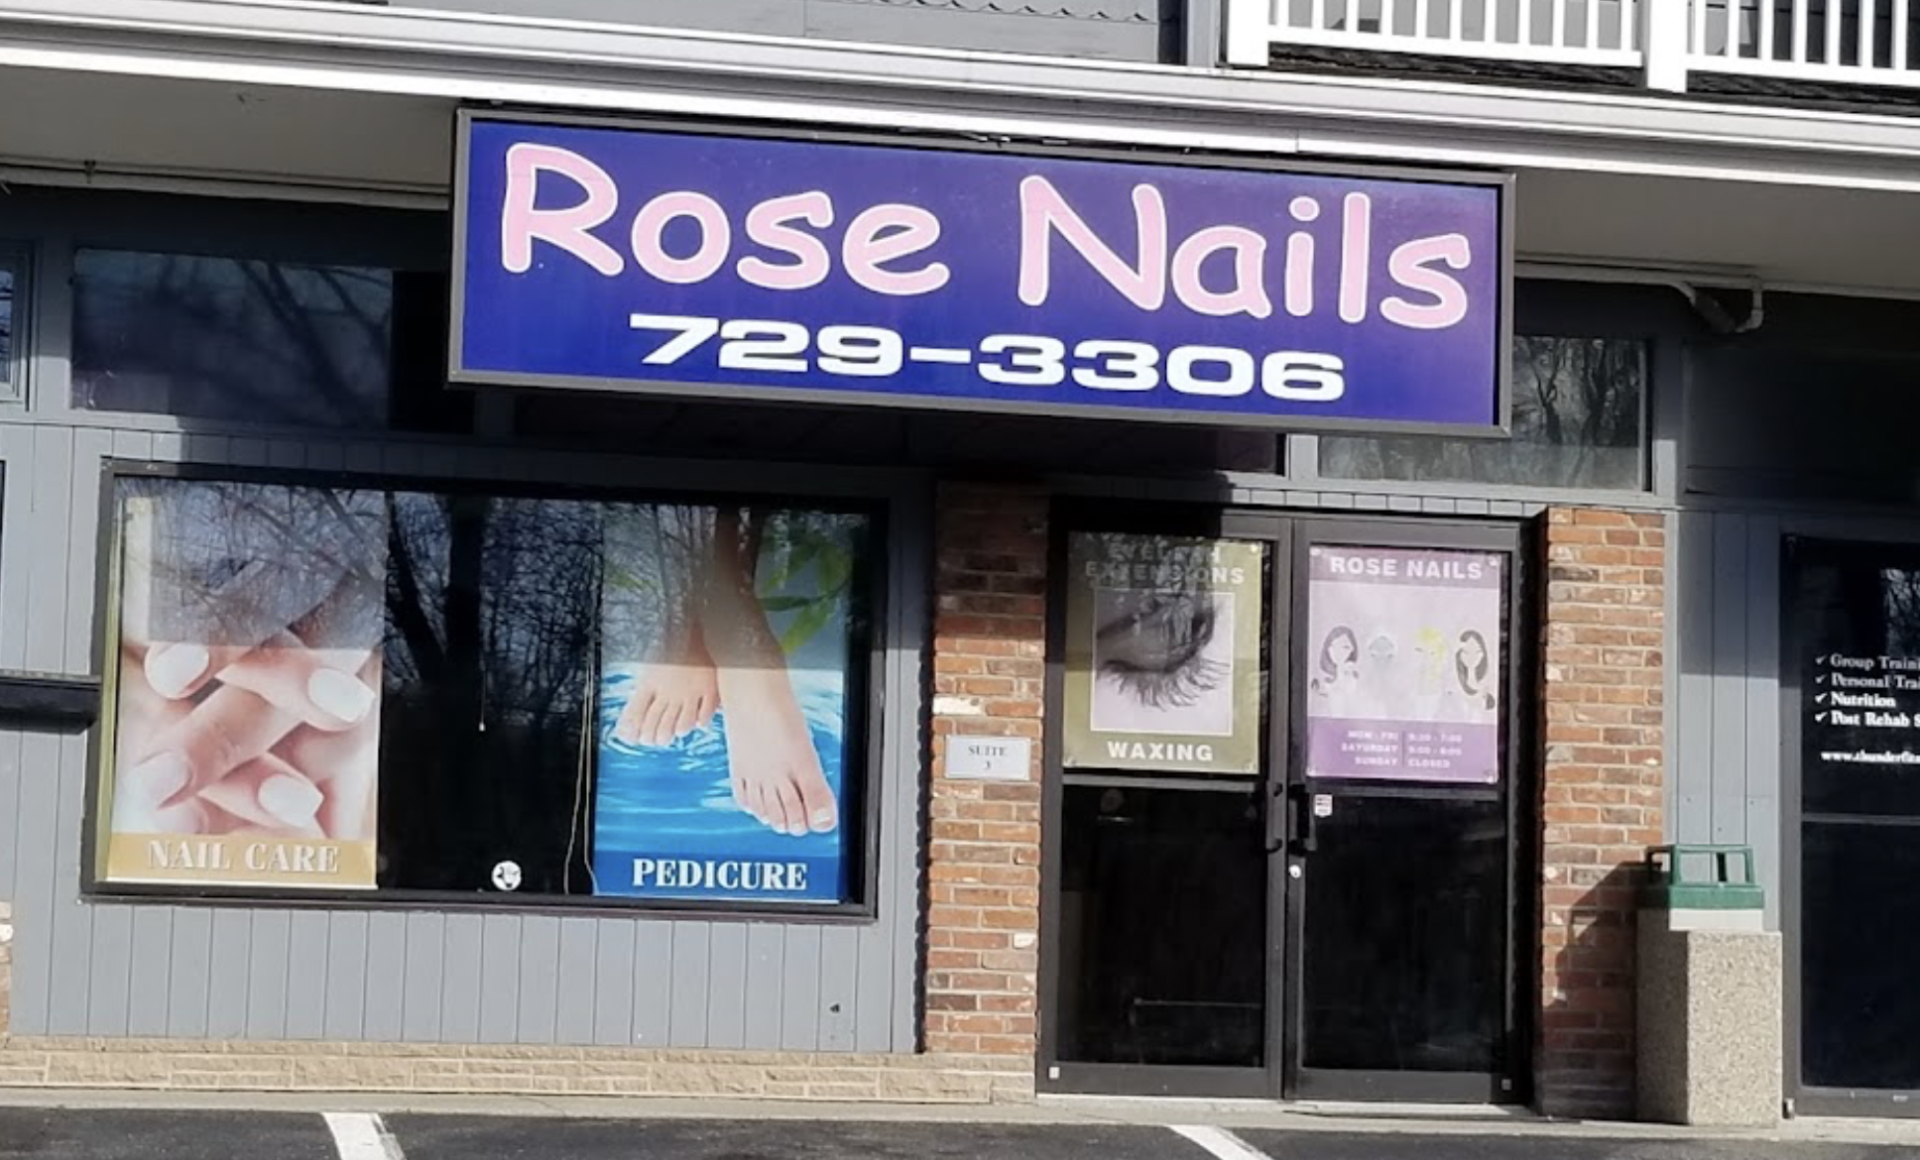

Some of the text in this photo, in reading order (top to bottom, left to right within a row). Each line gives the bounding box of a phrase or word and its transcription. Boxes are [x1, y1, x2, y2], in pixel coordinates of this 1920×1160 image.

[502, 142, 1471, 330] Rose Nails
[629, 313, 1345, 402] 729-3306
[1330, 556, 1482, 580] ROSE NAILS
[1830, 653, 1875, 671] Group
[1831, 672, 1889, 688] Personal
[1830, 691, 1896, 708] Nutrition
[1831, 710, 1860, 726] Post
[1864, 711, 1910, 727] Rehab
[968, 745, 1007, 756] SUITE
[1107, 741, 1214, 762] WAXING
[1341, 742, 1399, 753] SATURDAY
[1354, 756, 1451, 769] SUNDAY CLOSED
[148, 840, 339, 873] NAIL CARE
[632, 858, 807, 891] PEDICURE
